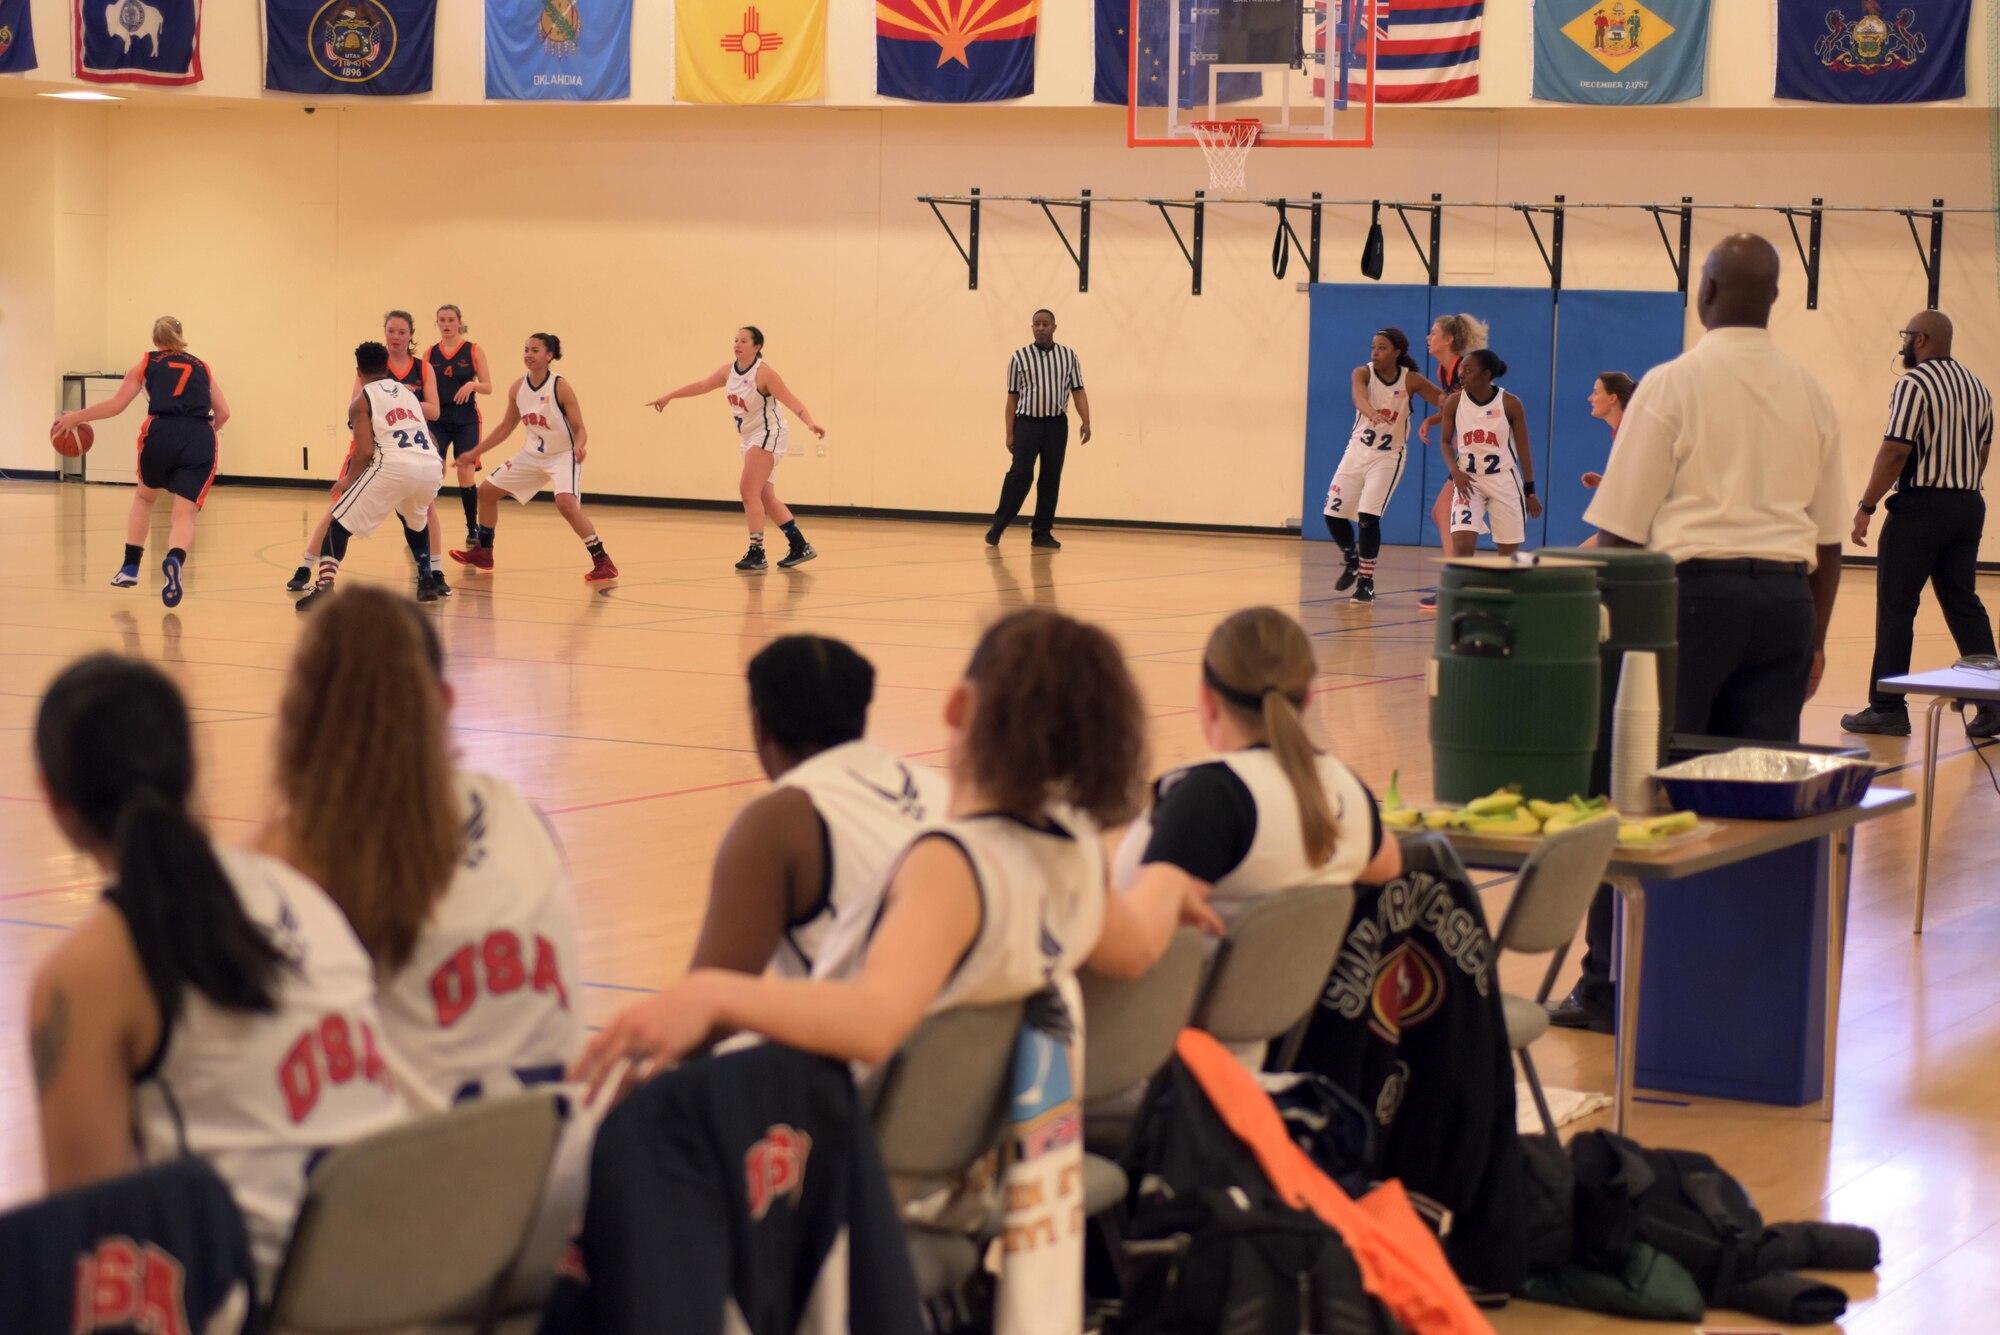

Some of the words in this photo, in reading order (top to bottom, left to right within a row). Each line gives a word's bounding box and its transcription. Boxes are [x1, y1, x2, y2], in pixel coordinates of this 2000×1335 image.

[342, 68, 362, 76] 1896
[533, 74, 582, 86] OKLAHOMA
[1580, 81, 1623, 89] DECEMBER
[168, 361, 192, 397] 7
[444, 366, 453, 377] 4
[385, 407, 421, 427] USA
[392, 430, 430, 450] 24
[1360, 429, 1393, 450] 32
[1463, 429, 1499, 448] USA
[1466, 453, 1500, 475] 12
[1451, 510, 1472, 525] 12
[428, 930, 571, 1028] USA
